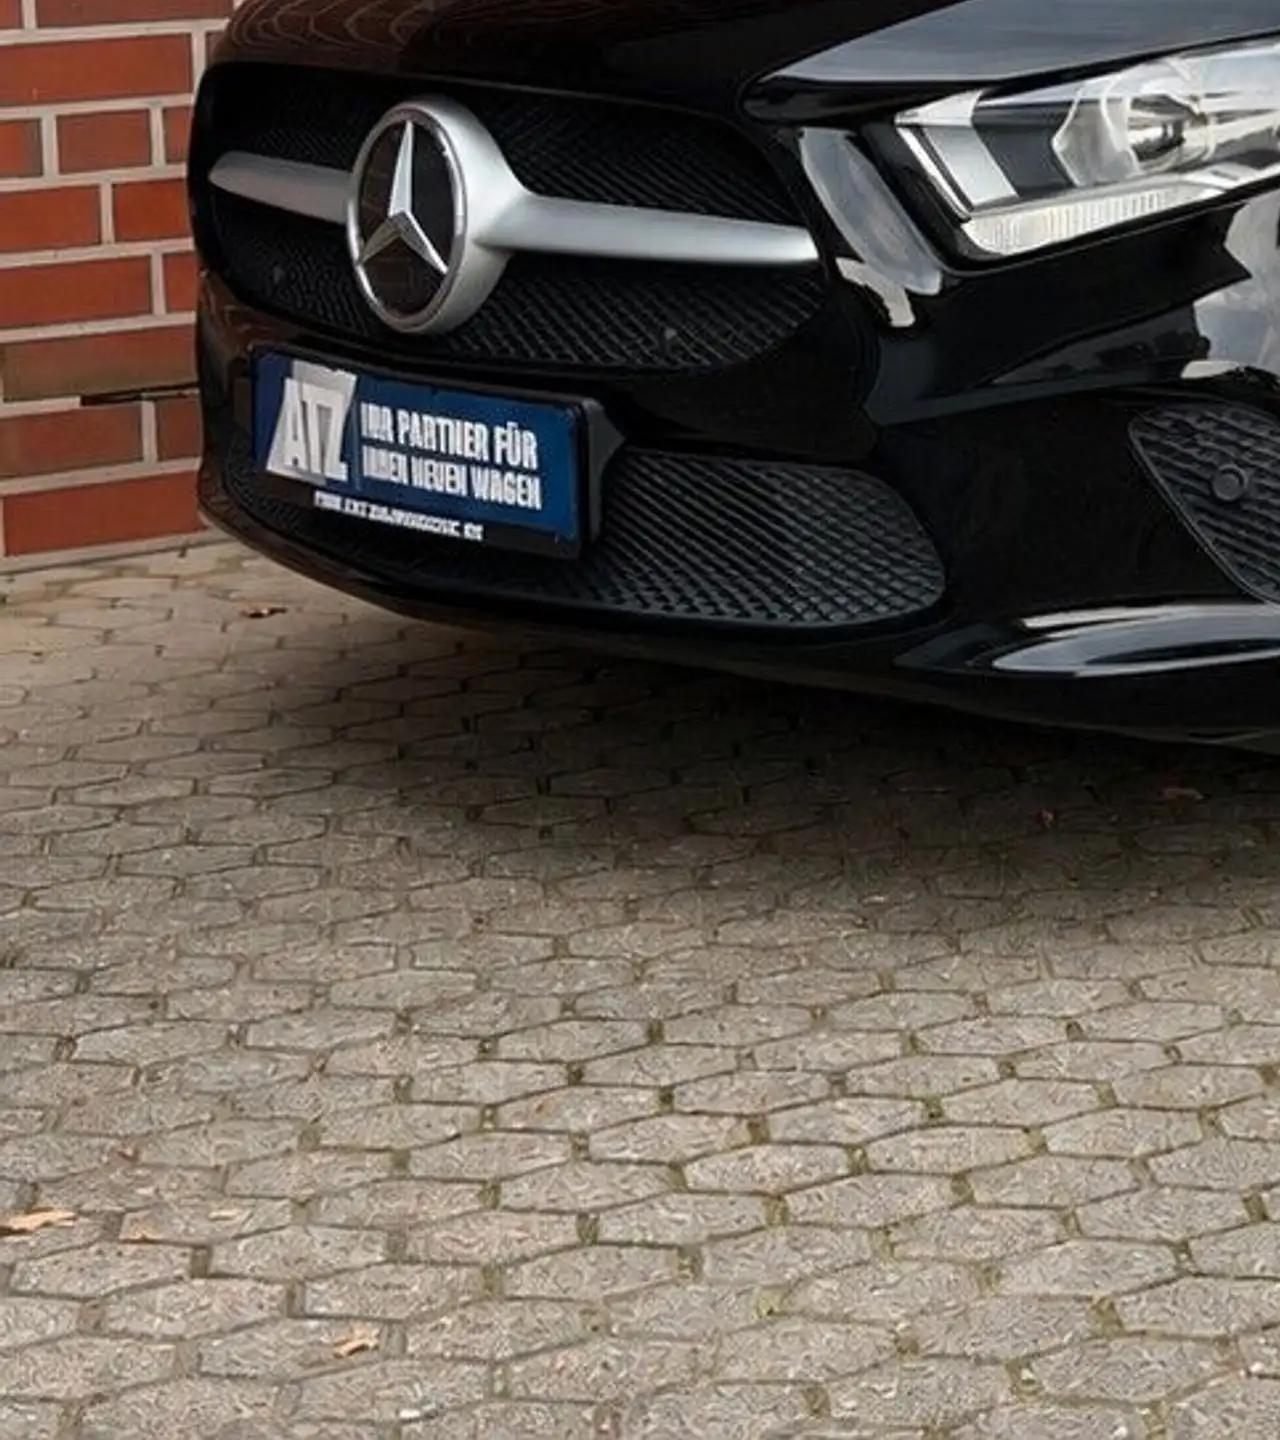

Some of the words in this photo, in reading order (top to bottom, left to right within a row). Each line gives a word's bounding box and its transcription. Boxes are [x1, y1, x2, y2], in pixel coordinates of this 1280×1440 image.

[266, 360, 357, 484] ATZ
[397, 410, 489, 461] PARTNER
[493, 421, 538, 470] FÜR
[470, 465, 542, 511] WAGEN
